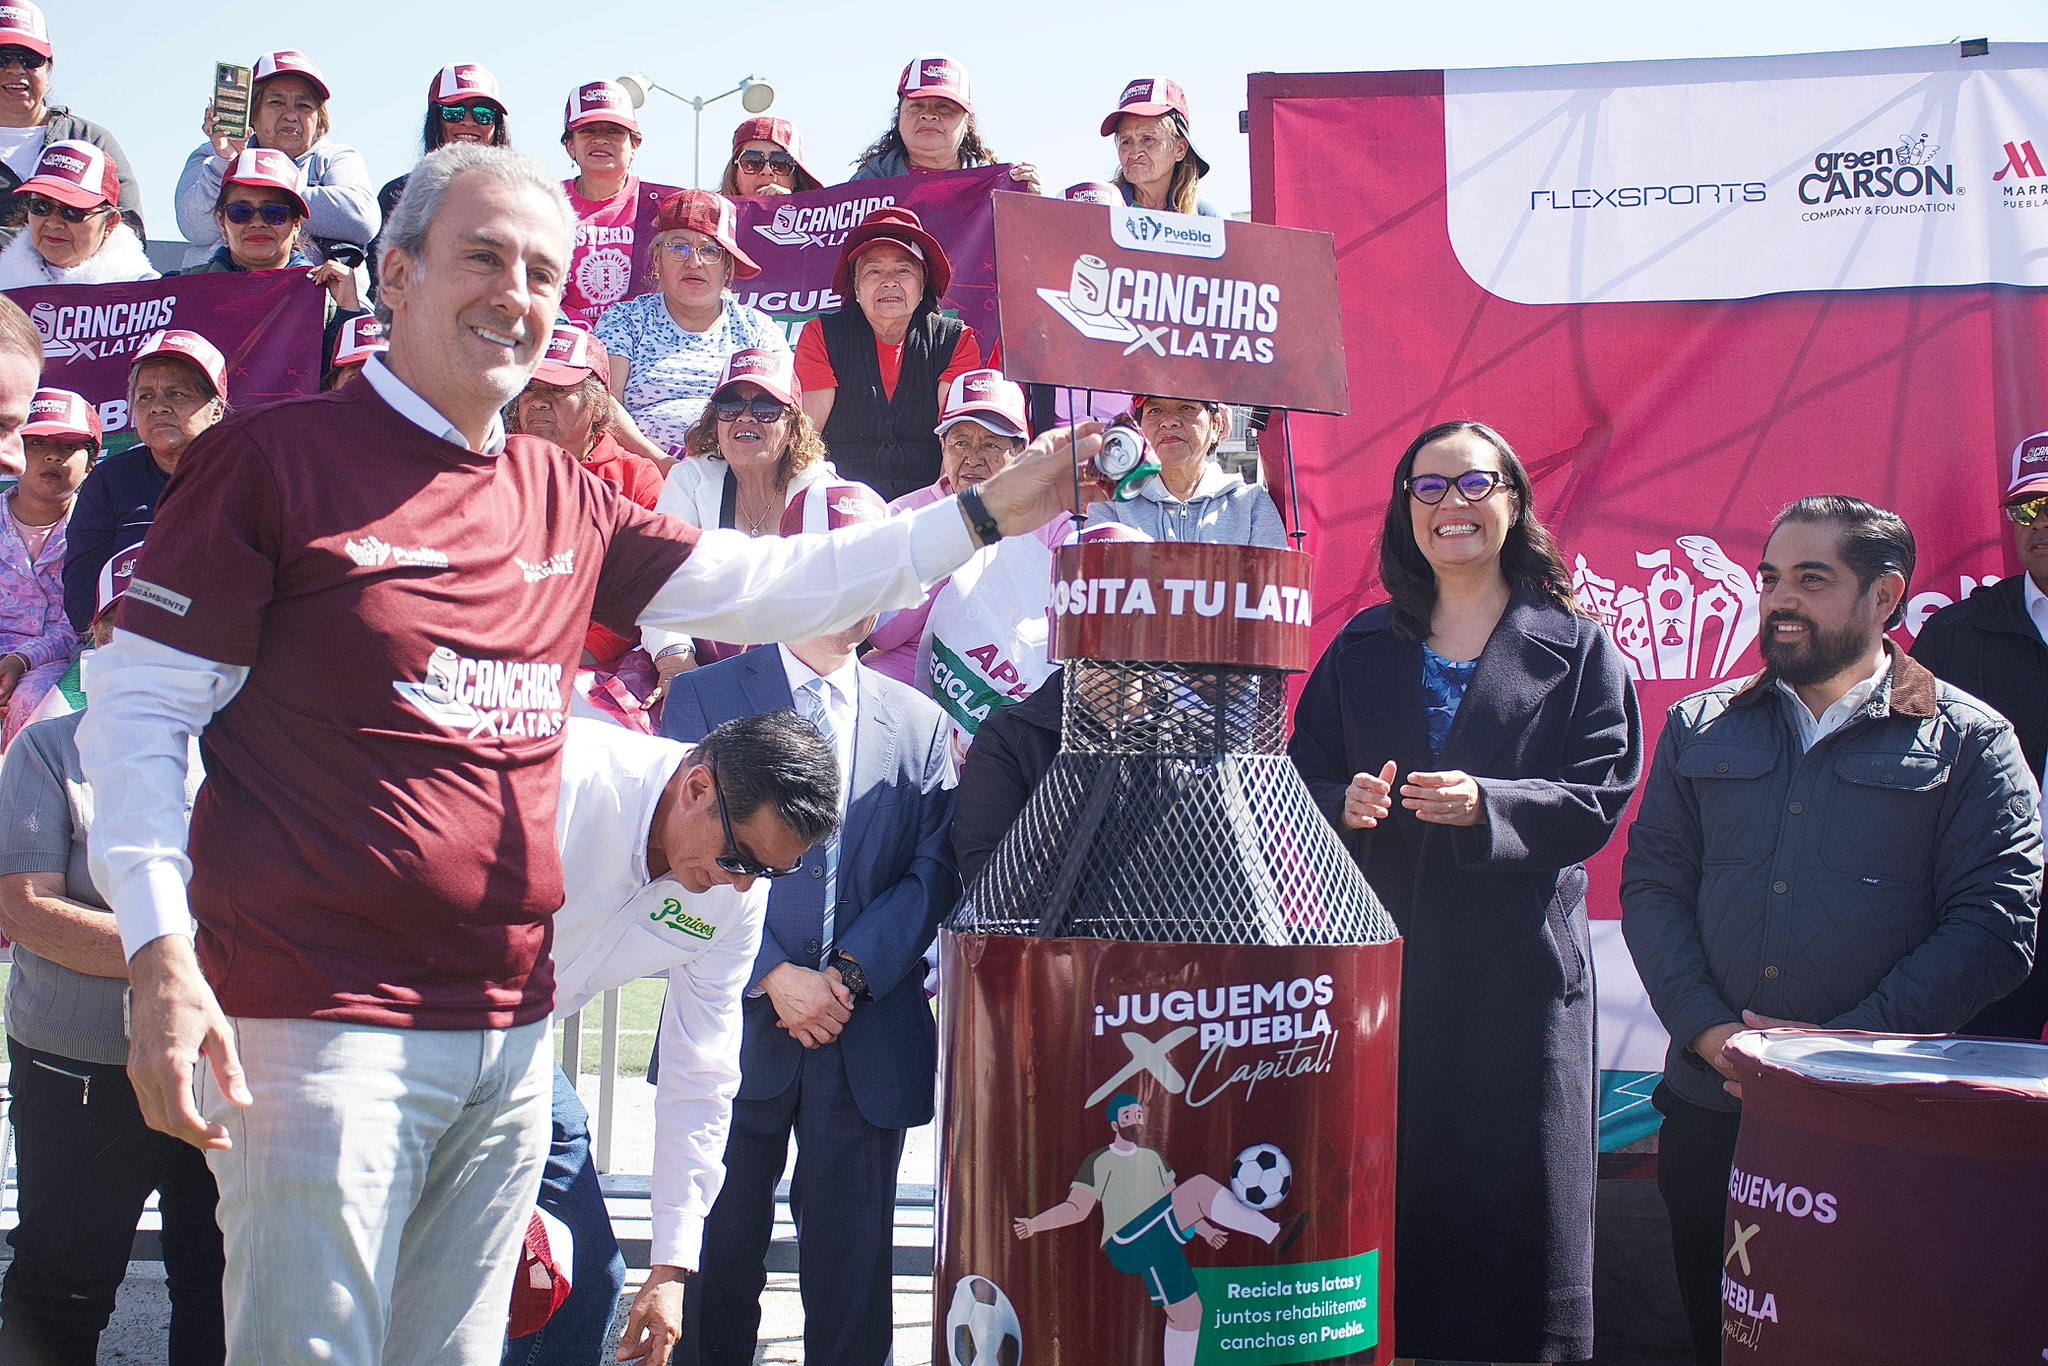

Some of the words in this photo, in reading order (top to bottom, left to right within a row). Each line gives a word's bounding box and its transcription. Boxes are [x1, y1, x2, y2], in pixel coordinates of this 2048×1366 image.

[1815, 147, 1893, 178] green
[1531, 182, 1766, 210] FLEXSPORTS
[1798, 164, 1953, 205] CARSON
[1801, 206, 1861, 222] COMPANY
[1864, 207, 1873, 215] &
[1875, 203, 1955, 216] FOUNDATION
[1164, 226, 1212, 243] Puebla
[56, 296, 176, 341] CANCHAS
[1108, 267, 1280, 333] CANCHAS
[1169, 328, 1274, 363] LATAS
[1163, 579, 1226, 617] TU
[1234, 582, 1312, 627] LATA
[456, 658, 563, 710] CANCHAS
[500, 711, 563, 738] LATAS
[650, 898, 717, 940] Pericos
[1094, 974, 1334, 1036] ¡JUGUEMOS
[1200, 1009, 1332, 1050] PUEBLA
[1185, 1030, 1339, 1108] Capital!
[1728, 1164, 1838, 1224] GUEMOS
[1228, 1281, 1292, 1299] Recicla
[1295, 1280, 1319, 1295] tus
[1321, 1275, 1355, 1292] latas
[1355, 1274, 1362, 1291] y
[1214, 1308, 1271, 1329] juntos
[1276, 1296, 1367, 1322] rehabilitemos
[1220, 1332, 1295, 1351] canchas
[1299, 1331, 1318, 1345] en
[1321, 1320, 1364, 1343] Puebla.
